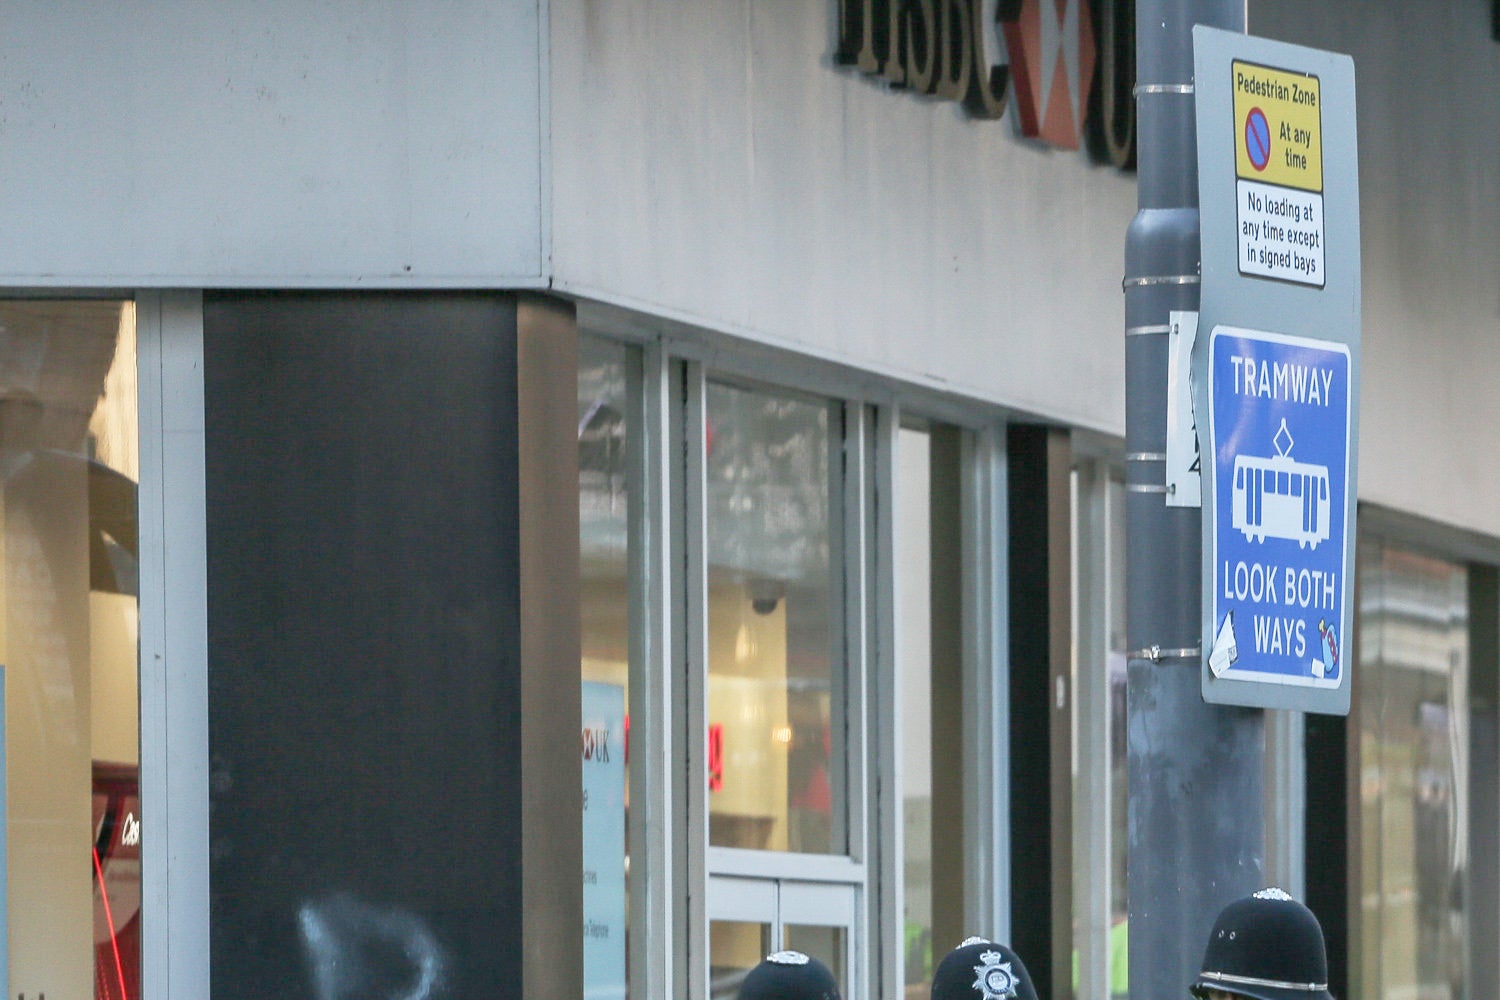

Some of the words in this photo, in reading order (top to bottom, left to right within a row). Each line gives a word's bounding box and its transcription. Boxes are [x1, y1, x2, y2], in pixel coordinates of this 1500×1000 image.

[1237, 72, 1290, 101] Pedestrian
[1292, 84, 1316, 107] Zone
[1280, 121, 1291, 142] At
[1294, 128, 1311, 149] any
[1286, 148, 1307, 170] time
[1248, 191, 1262, 212] No
[1265, 194, 1300, 223] loading
[1303, 203, 1314, 222] at
[1242, 220, 1260, 241] any
[1263, 219, 1284, 242] time
[1287, 229, 1320, 251] except
[1247, 242, 1257, 262] in
[1259, 245, 1291, 269] signed
[1294, 251, 1316, 275] bays
[1230, 356, 1334, 408] TRAMWAY
[1224, 560, 1277, 604] LOOK
[1284, 567, 1335, 610] BOTH
[1253, 614, 1307, 659] WAYS
[595, 728, 610, 764] UK
